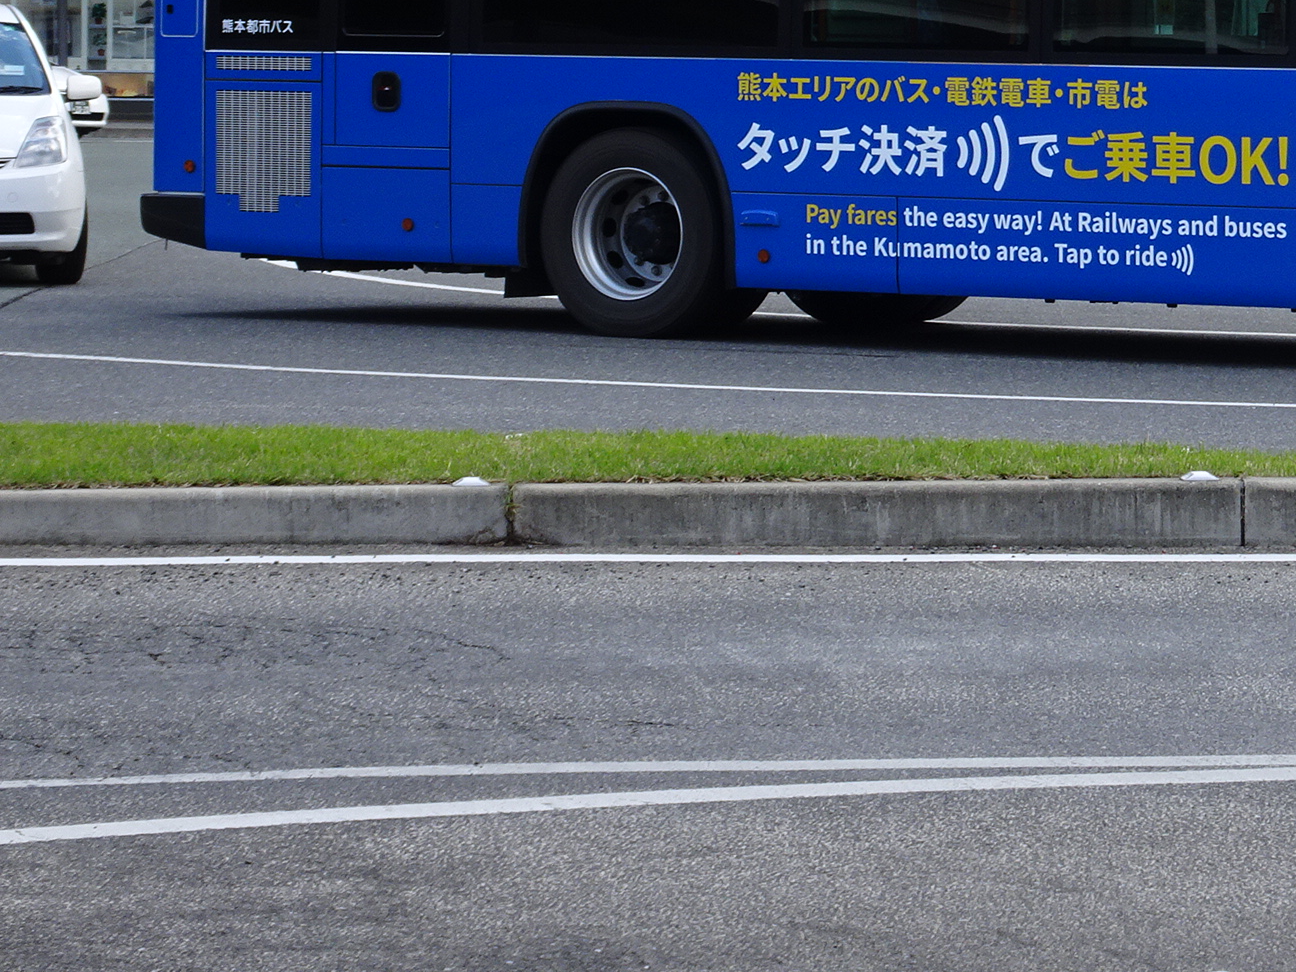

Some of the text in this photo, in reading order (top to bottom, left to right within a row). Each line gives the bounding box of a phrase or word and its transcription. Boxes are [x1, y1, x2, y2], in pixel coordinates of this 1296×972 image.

[222, 19, 293, 34] 熊本都市バス
[737, 72, 1148, 110] 熊本エリアのバス・電鉄電車・市電は
[737, 122, 1290, 187] タッチ決済 でご乗車OK!
[806, 204, 1287, 239] Pay fares the easy way! At Railways and buses
[805, 233, 1168, 269] in the Kumamoto area. Tap to ride
